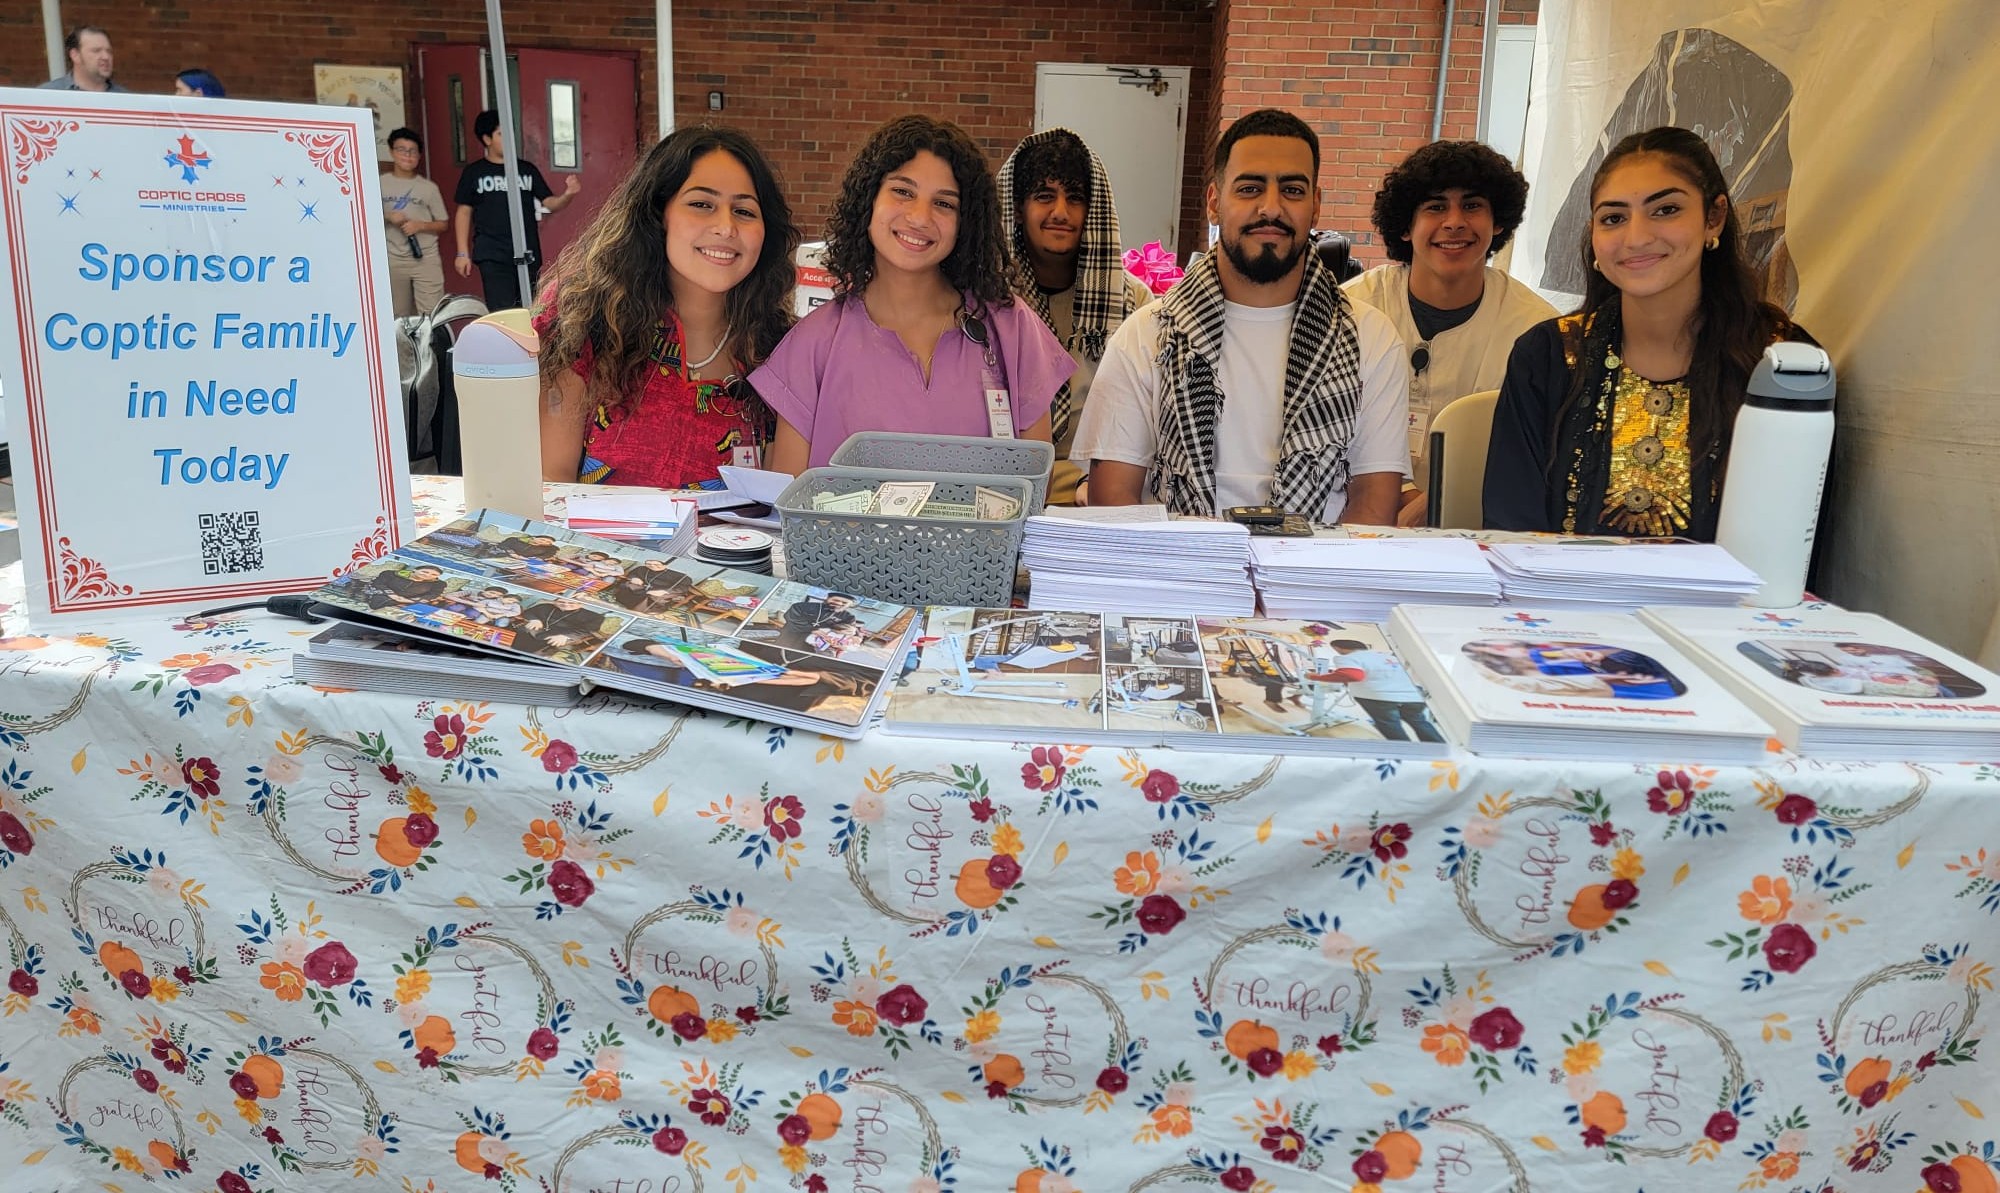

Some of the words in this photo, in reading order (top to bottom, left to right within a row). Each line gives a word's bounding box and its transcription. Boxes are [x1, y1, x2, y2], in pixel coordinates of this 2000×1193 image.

[138, 190, 192, 201] COPTIC
[195, 192, 246, 203] CROSS
[476, 174, 533, 194] JORAN
[162, 204, 226, 213] MINISTRIES
[79, 242, 277, 291] Sponsor
[288, 255, 311, 284] a
[45, 313, 197, 361] Coptic
[213, 312, 357, 359] Family
[127, 381, 168, 419] in
[185, 378, 299, 418] Need
[152, 446, 290, 491] Today
[323, 753, 371, 863] thankful
[905, 793, 956, 903] thankful
[1515, 818, 1571, 931] thankful
[95, 906, 185, 949] thankful
[646, 950, 759, 992] thankful
[454, 953, 507, 1055] grateful
[1231, 978, 1352, 1021] thankful
[1025, 993, 1076, 1090] grateful
[1858, 1001, 1959, 1047] thankful
[1630, 1027, 1684, 1137] grateful
[88, 1099, 165, 1133] grateful
[296, 1064, 339, 1156] thankful
